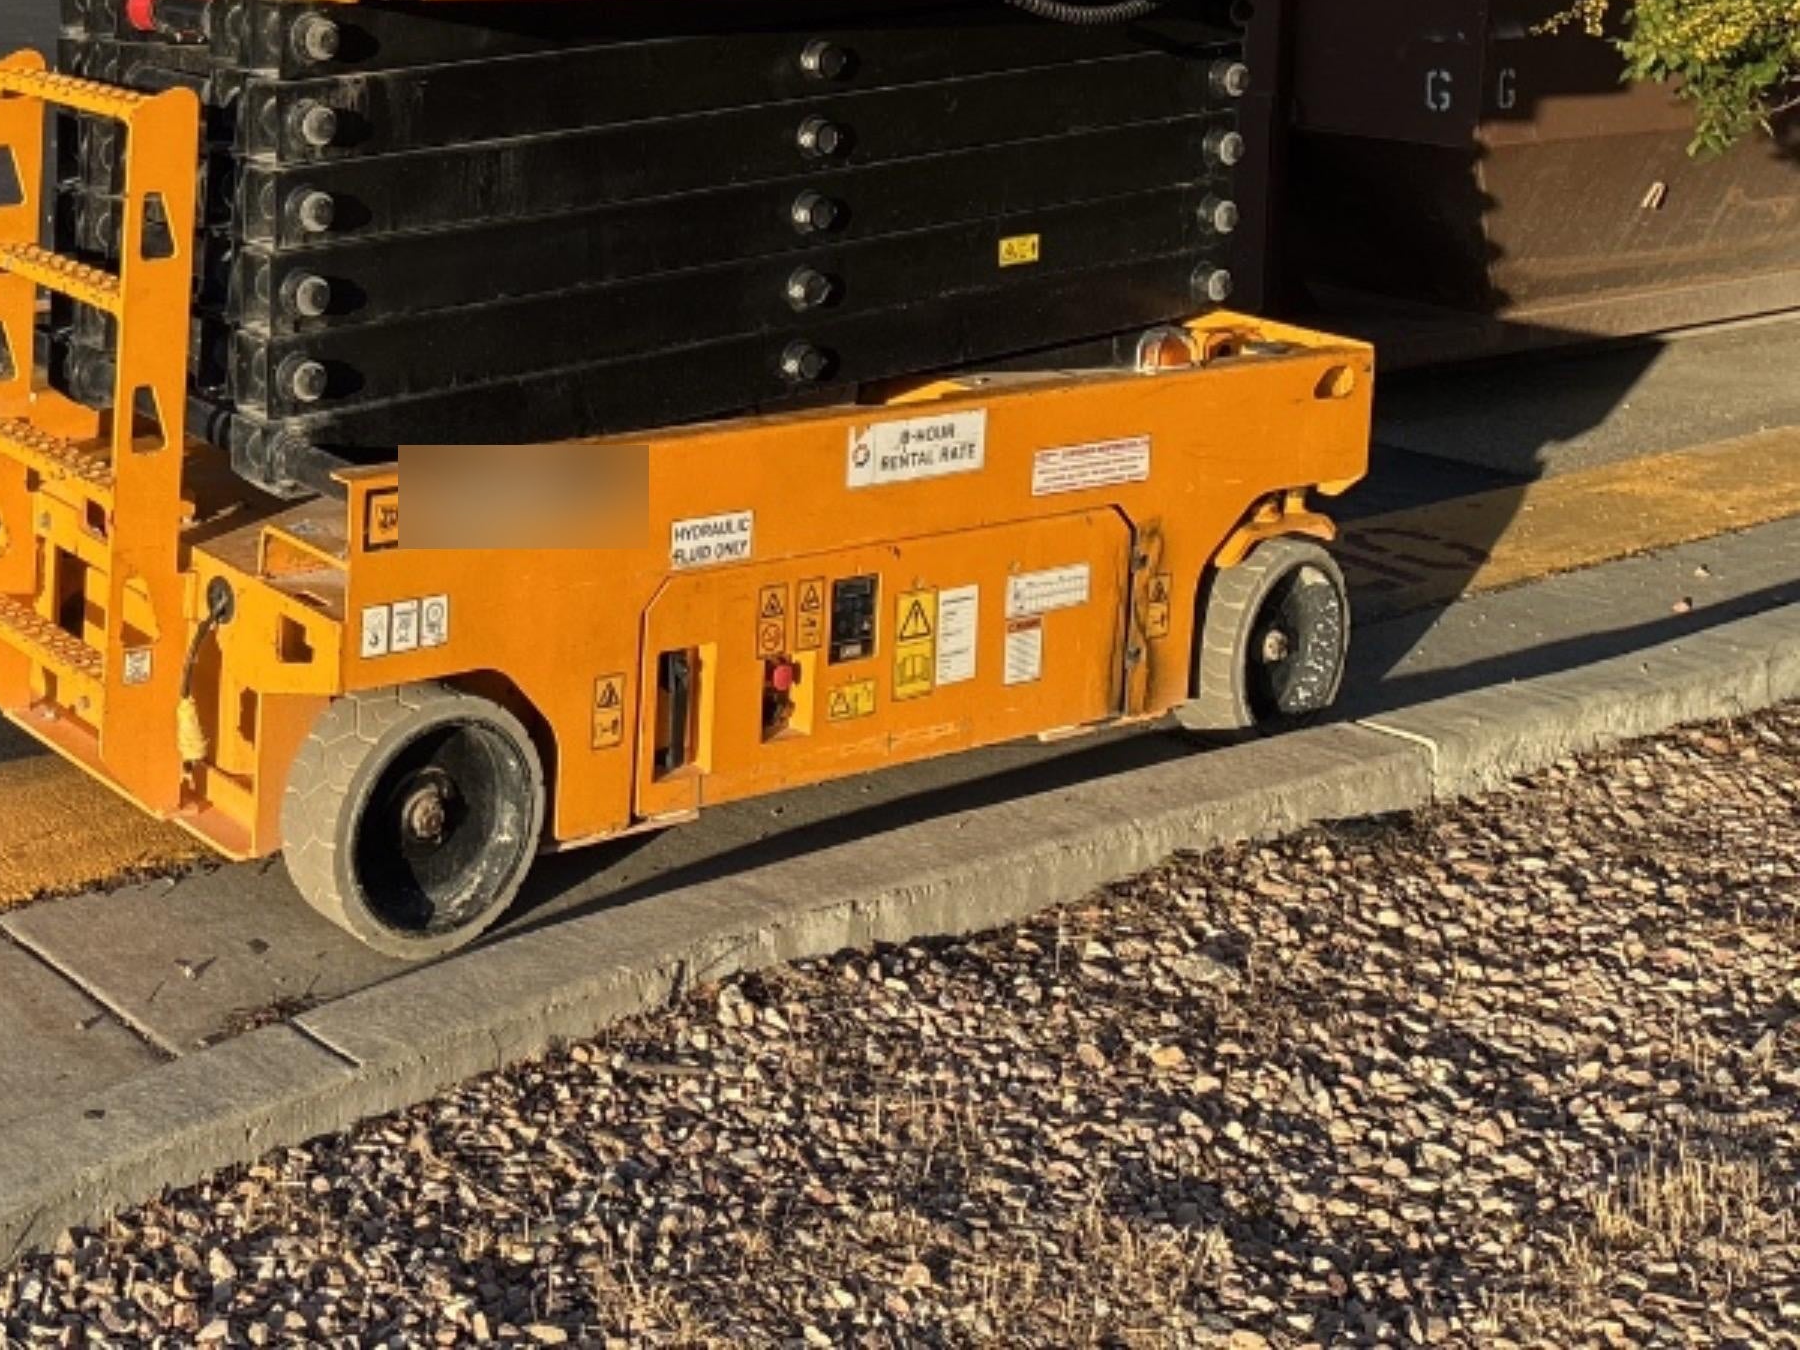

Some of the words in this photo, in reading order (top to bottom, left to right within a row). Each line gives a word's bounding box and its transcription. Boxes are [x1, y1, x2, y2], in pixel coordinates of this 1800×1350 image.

[1425, 68, 1453, 111] G
[880, 450, 935, 472] RENTAL
[939, 442, 977, 463] RATE
[674, 517, 750, 543] HYDRAULIC
[673, 544, 712, 565] FLUID
[714, 539, 749, 560] ONLY
